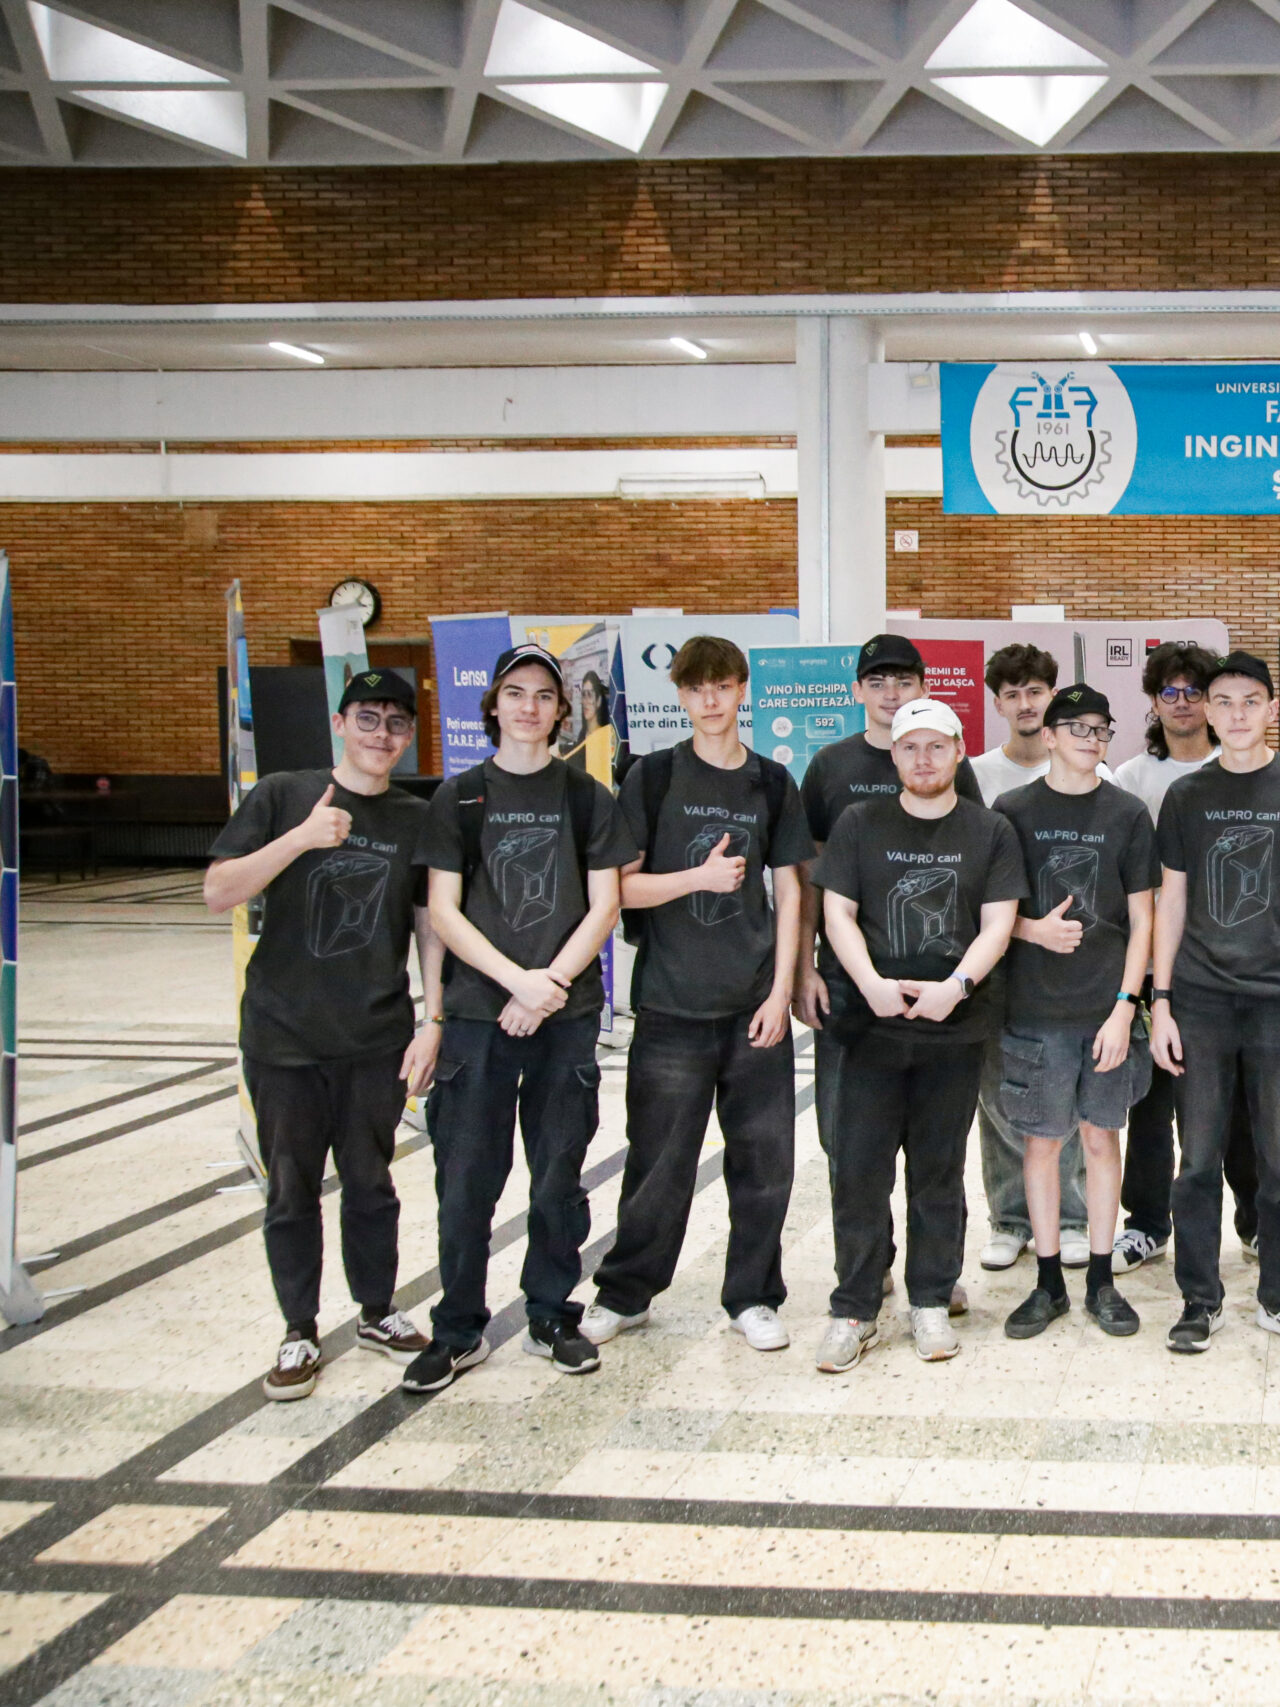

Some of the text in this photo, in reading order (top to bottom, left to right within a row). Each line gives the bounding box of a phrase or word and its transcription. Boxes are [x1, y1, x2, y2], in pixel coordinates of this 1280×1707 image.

[1037, 422, 1069, 435] 1961
[1110, 645, 1129, 656] IRL
[453, 666, 488, 687] Lensa
[924, 667, 966, 676] REMII DE
[765, 682, 848, 695] VINO ÎN ECHIPA
[758, 695, 855, 709] CARE CONTEAZĂ!
[628, 718, 655, 728] arte
[658, 717, 677, 728] din
[680, 718, 694, 728] Es
[815, 717, 835, 727] 592
[849, 784, 897, 794] VALPRO
[487, 812, 560, 823] VALPRO can
[683, 805, 730, 819] VALPRO
[1205, 809, 1280, 821] VALPRO can!
[1034, 829, 1078, 841] VALPRO
[886, 851, 934, 864] VALPRO
